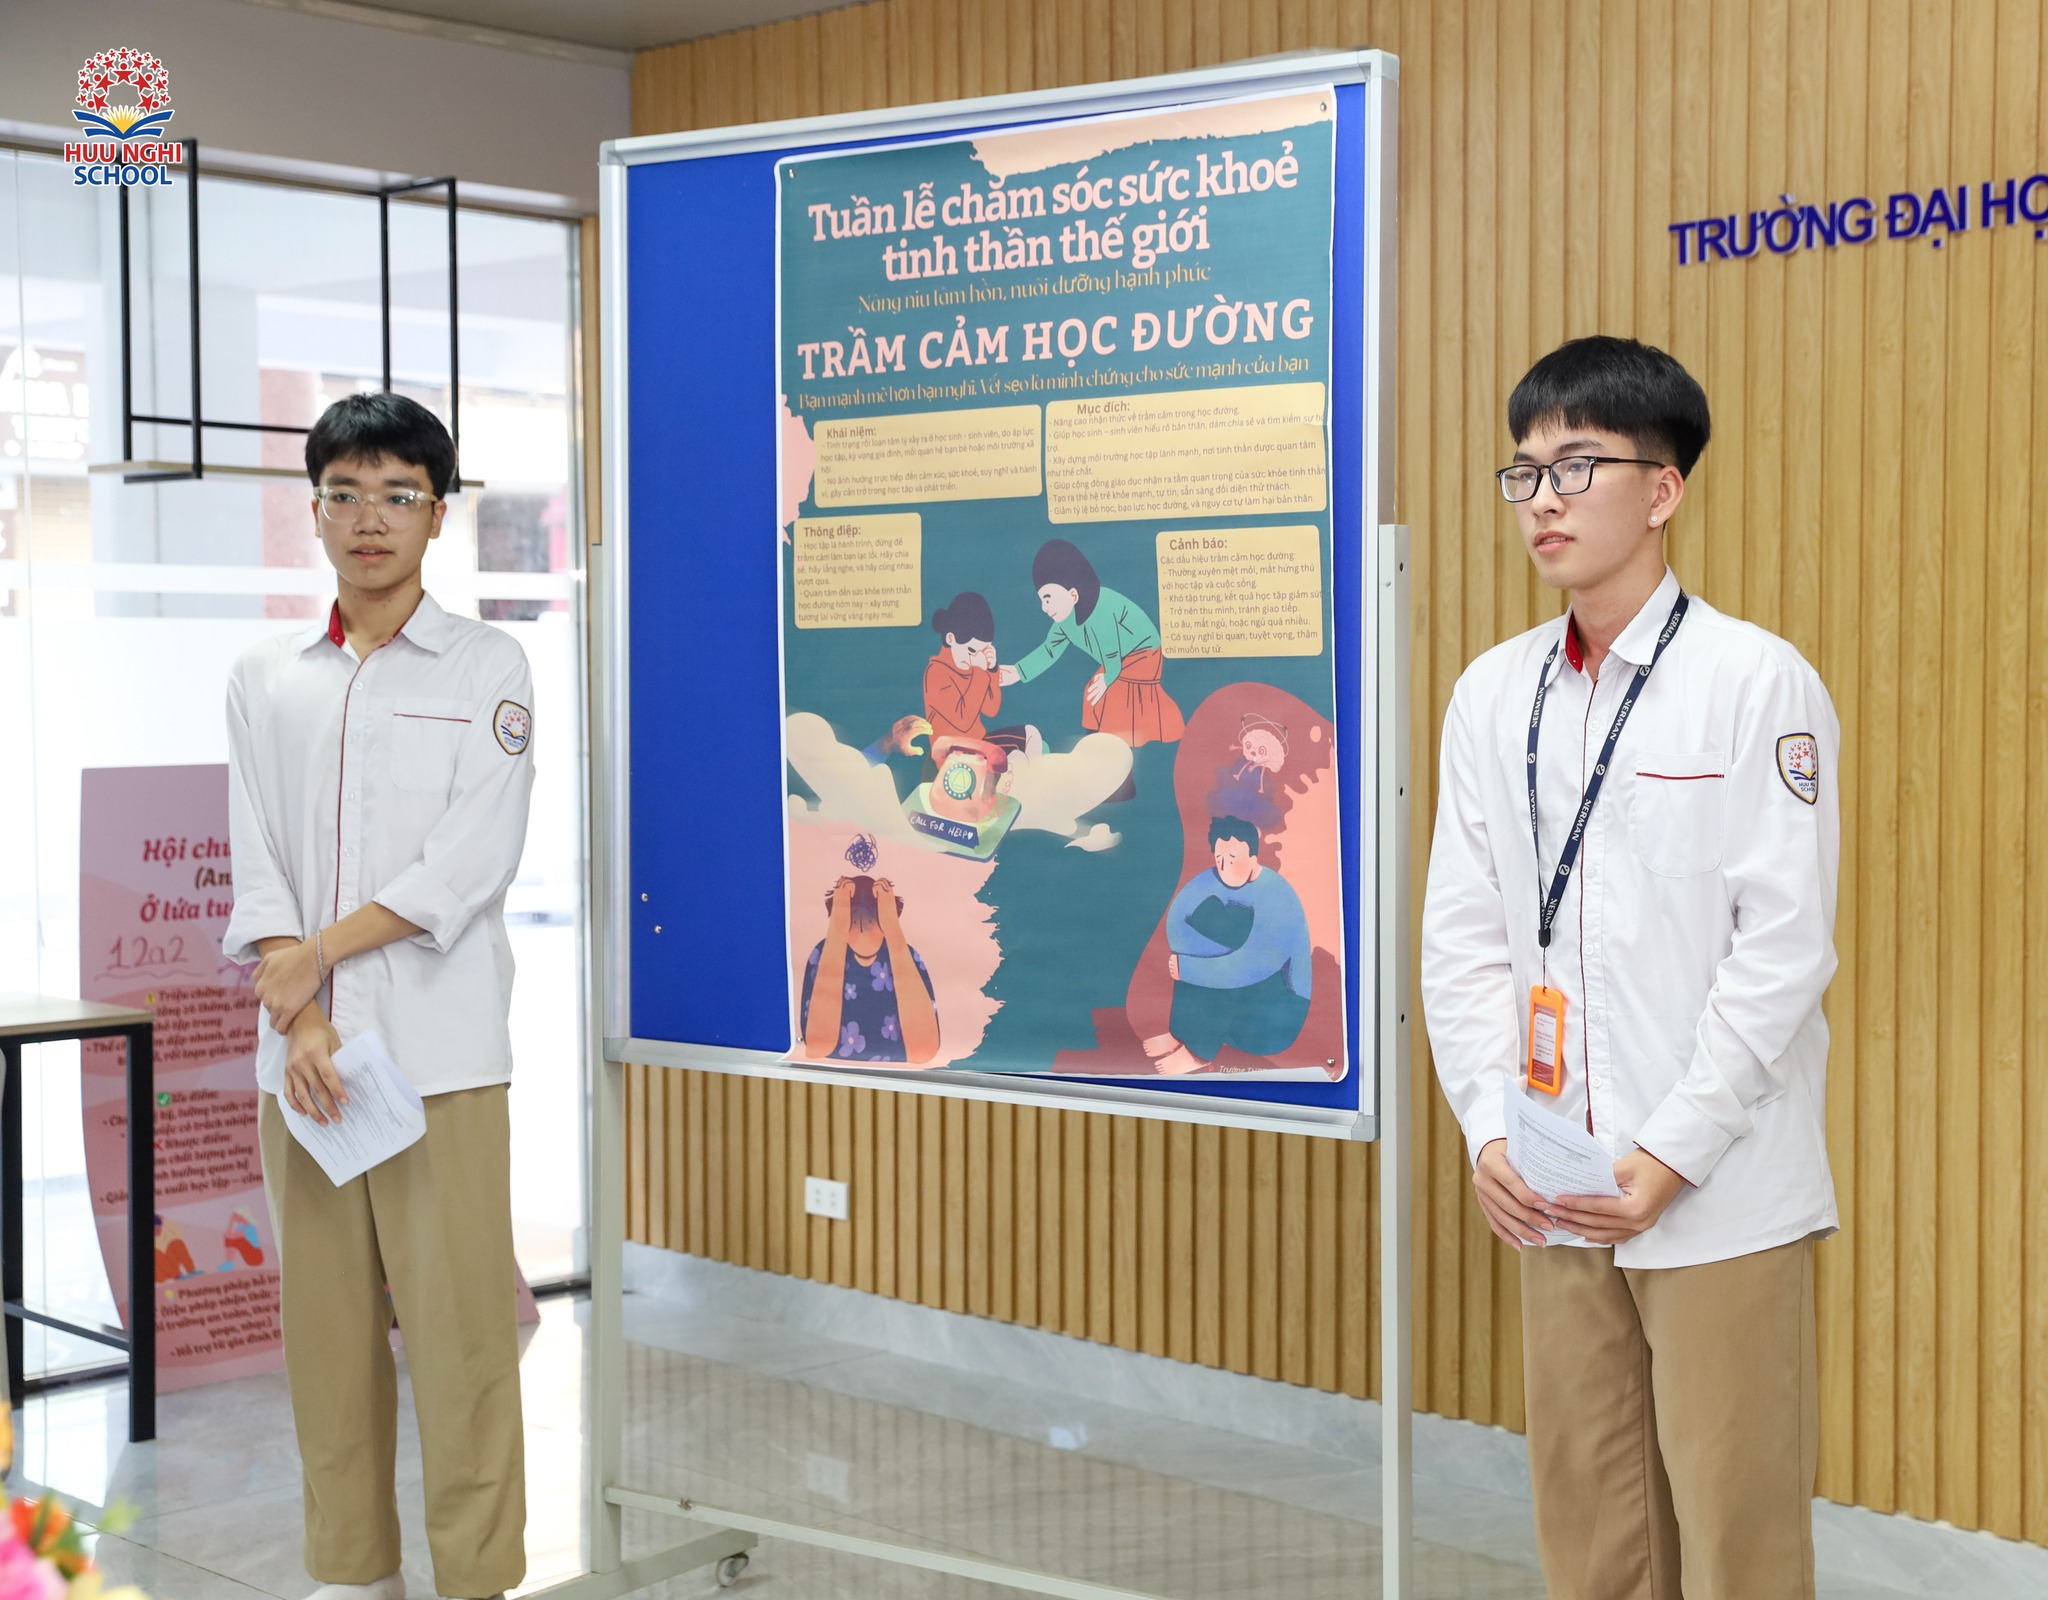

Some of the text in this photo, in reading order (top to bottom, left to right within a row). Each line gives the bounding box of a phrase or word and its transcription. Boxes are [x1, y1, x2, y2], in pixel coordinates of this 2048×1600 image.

[808, 140, 1298, 241] Tuần lễ chăm sóc sức khoẻ
[1668, 174, 2048, 265] TRƯỜNG ĐẠI HỌ
[882, 205, 1210, 282] tinh thần thế giới
[858, 262, 1211, 314] Nâng niu tâm hồn, nuôi dưỡng hạnh phúc
[797, 294, 1314, 380] TRẦM CẢM HỌC ĐƯỜNG
[799, 354, 1309, 411] Bạn mạnh mẽ hơn bạn nghĩ. Vết sẹo là minh chứng cho sức mạnh của bạn
[1073, 417, 1087, 426] cao
[1077, 400, 1131, 416] Mục đích:
[826, 425, 876, 439] Khái niệm:
[803, 524, 860, 539] Thông điệp:
[1169, 536, 1228, 550] Cảnh báo:
[1160, 551, 1295, 564] Các dấu hiệu trầm cảm học đường:
[1168, 562, 1314, 578] Thường xuyên mệt mỏi, mất hứng thú
[1658, 610, 1681, 645] NERMAN
[1531, 687, 1545, 728] NERMAN
[1610, 698, 1633, 741] NERMAN
[910, 816, 968, 839] CALL FOR HELP
[1571, 798, 1592, 842] NERMAN
[142, 836, 188, 868] Hội
[139, 893, 160, 923] Ở
[162, 897, 201, 921] lứa
[106, 934, 190, 971] 12a2
